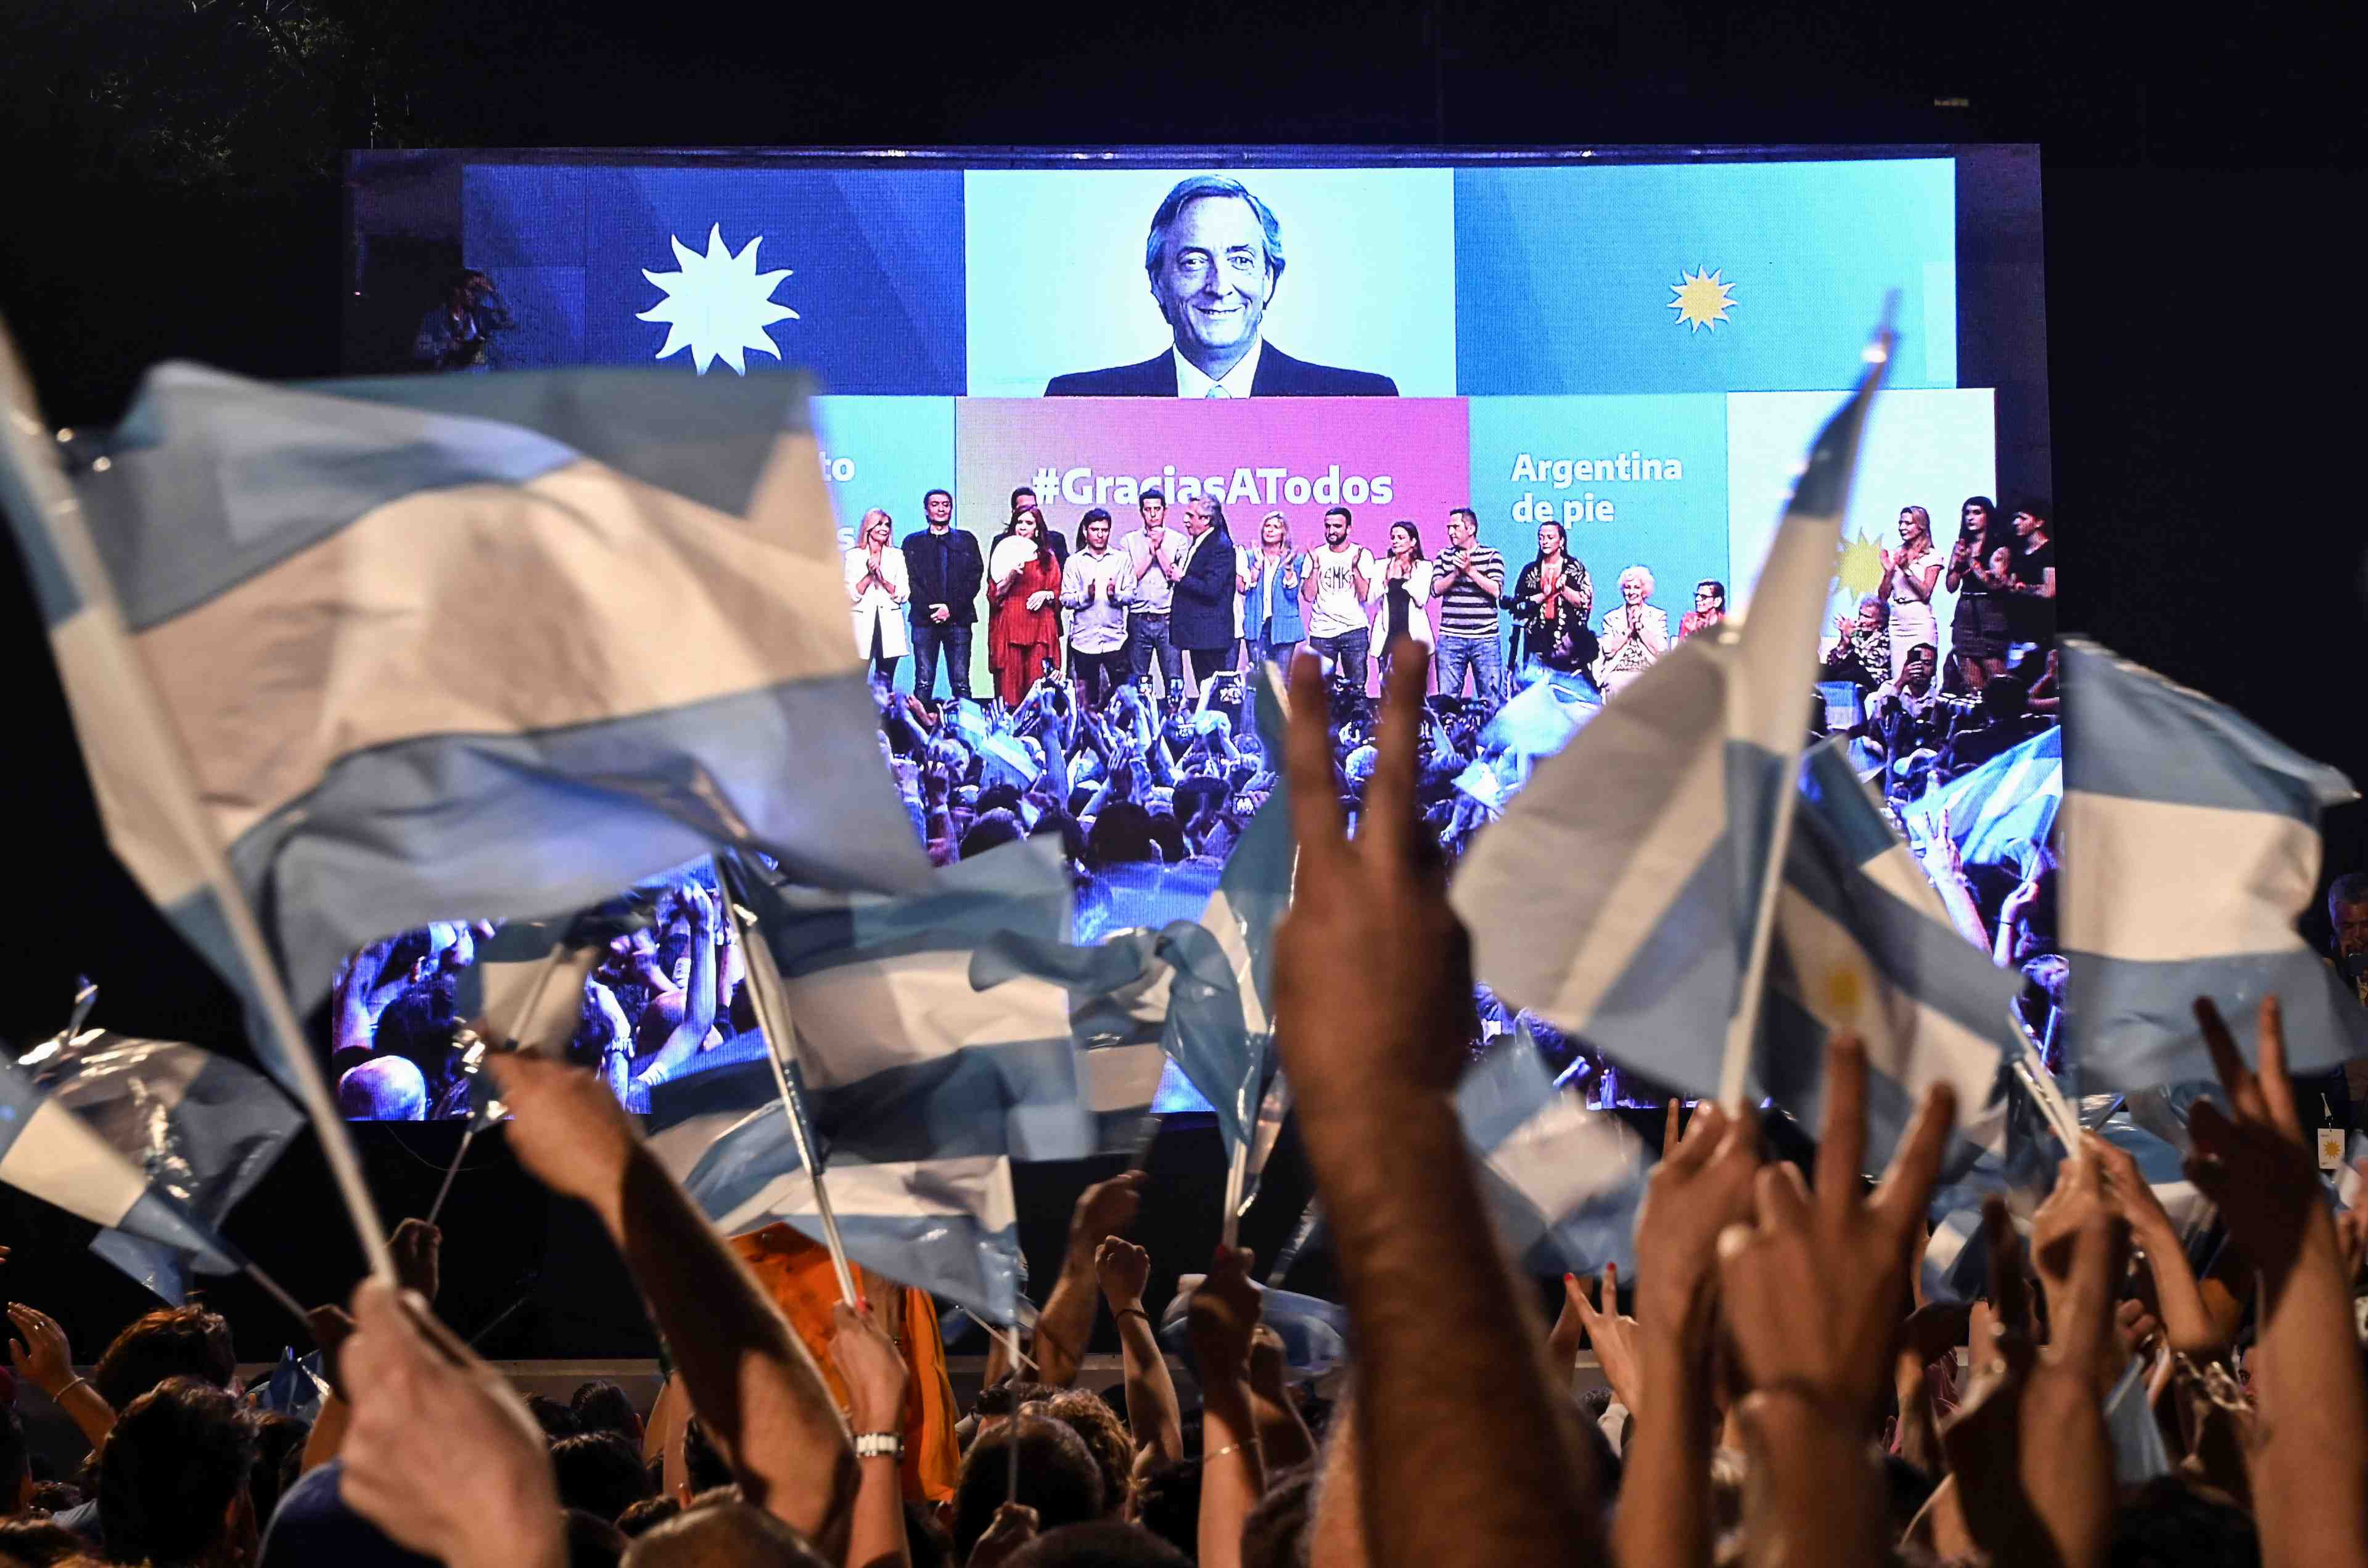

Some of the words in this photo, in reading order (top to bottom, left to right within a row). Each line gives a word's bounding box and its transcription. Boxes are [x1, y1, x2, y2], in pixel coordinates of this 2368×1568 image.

[1032, 465, 1393, 504] #GraciasATodos
[1510, 450, 1683, 488] Argentina
[1511, 492, 1553, 522] de
[1563, 492, 1614, 529] pie
